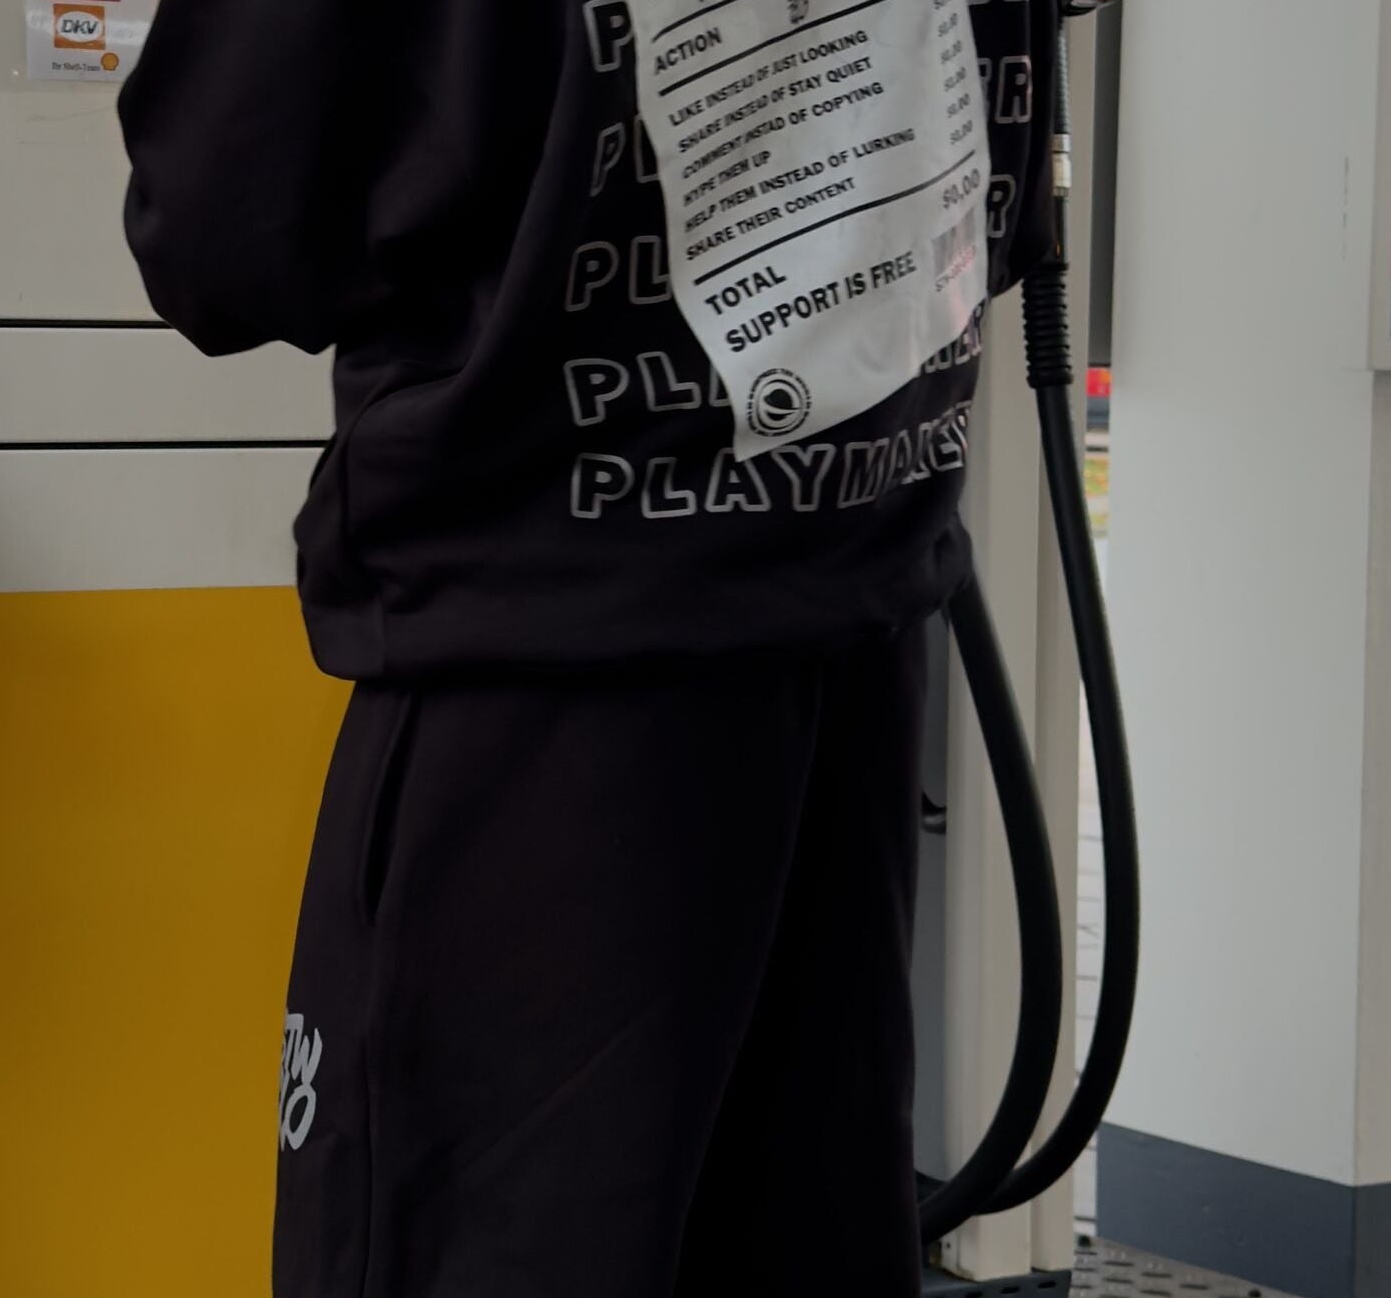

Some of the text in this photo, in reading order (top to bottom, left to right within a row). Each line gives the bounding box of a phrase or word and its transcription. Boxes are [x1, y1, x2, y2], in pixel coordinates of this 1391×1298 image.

[60, 18, 98, 35] DKV
[654, 26, 724, 77] ACTION
[668, 98, 705, 128] LIKE
[799, 29, 870, 65] LOOKING
[678, 118, 724, 153] SHARE
[787, 72, 823, 98] STAY
[827, 56, 874, 85] QUIET
[681, 135, 744, 180] COMMENT
[788, 108, 810, 127] OF
[811, 81, 885, 118] COPYING
[682, 150, 773, 208] HYPE THEM UP
[684, 203, 717, 234] HELP
[719, 180, 758, 213] THEM
[759, 160, 826, 195] INSTEAD
[828, 150, 849, 169] OF
[685, 176, 857, 262] SHARE THEIR CONTENT
[942, 167, 982, 210] $0.00
[705, 265, 788, 316] TOTAL
[725, 282, 842, 354] SUPPORT
[846, 272, 867, 300] IS
[870, 250, 918, 290] FREE
[570, 400, 972, 520] PLAYMAKE
